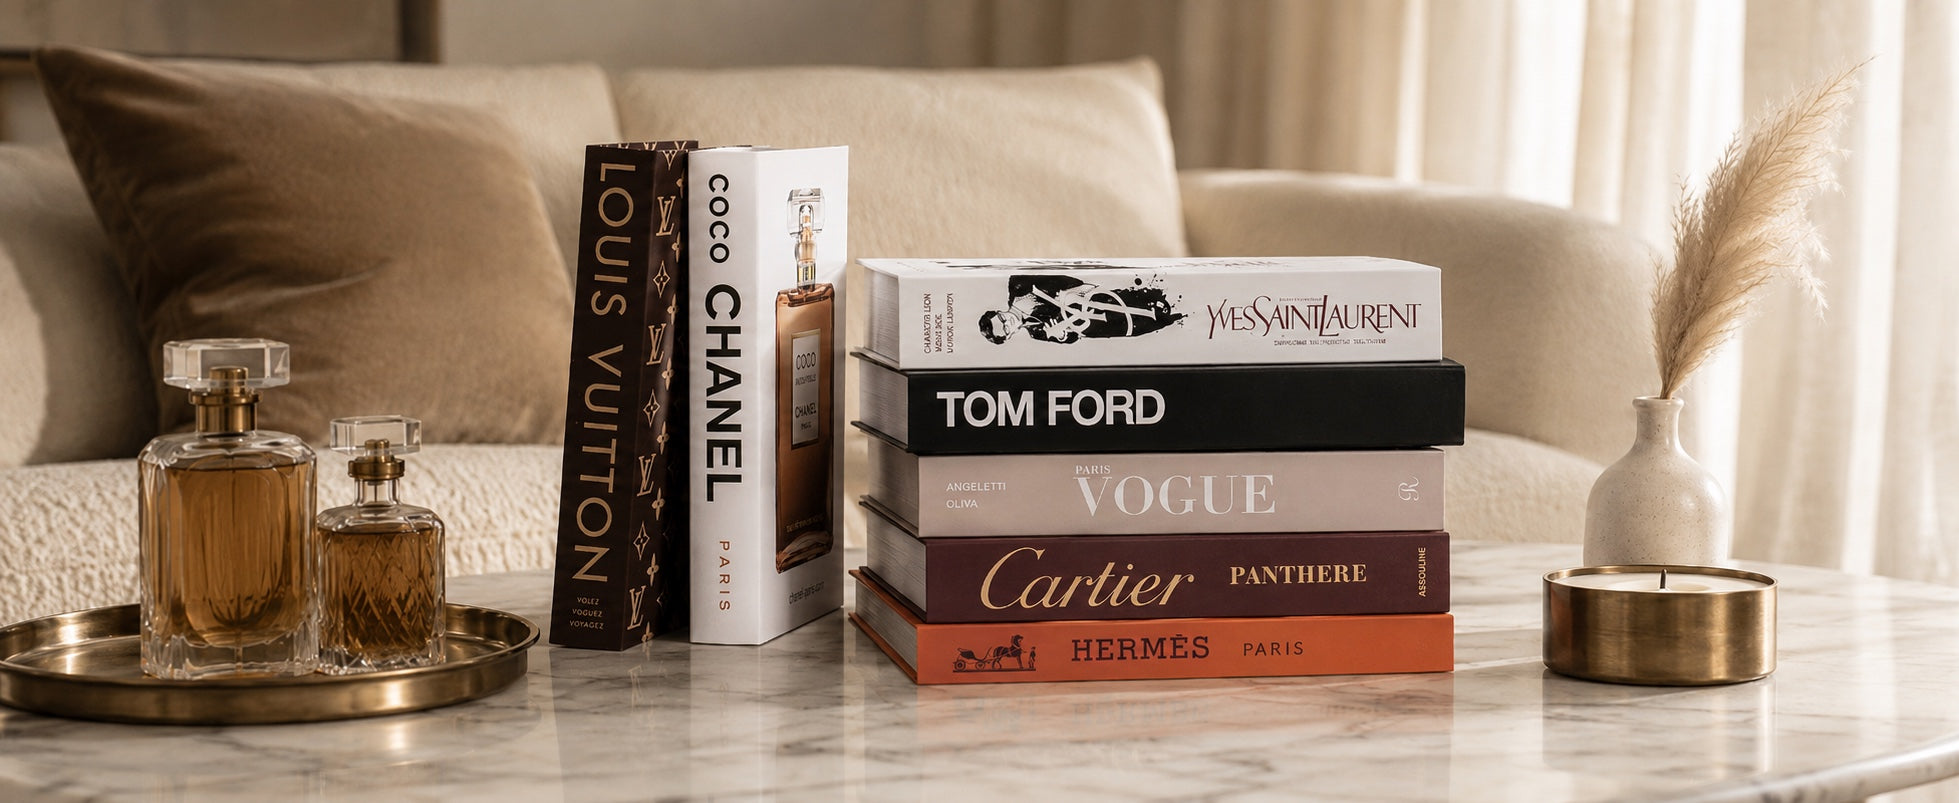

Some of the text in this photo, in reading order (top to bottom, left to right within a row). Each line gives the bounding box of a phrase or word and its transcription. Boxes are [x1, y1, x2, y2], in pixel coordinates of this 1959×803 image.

[705, 173, 742, 503] COCO CHANEL
[571, 162, 636, 582] LOUIS VUITTON
[936, 388, 1166, 428] TOM FORD
[1075, 464, 1110, 475] PARIS
[945, 482, 1007, 492] ANGELETTI
[1073, 474, 1275, 517] VOGUE
[945, 499, 979, 509] OLIVA
[718, 540, 731, 611] PARIS
[980, 545, 1367, 610] Cartier PANTHERE
[1418, 547, 1427, 597] ASSOULINE
[572, 608, 603, 618] VOGUEZ
[577, 597, 600, 605] VOLEZ
[569, 620, 605, 630] VOYAGEZ
[1243, 641, 1304, 657] PARIS
